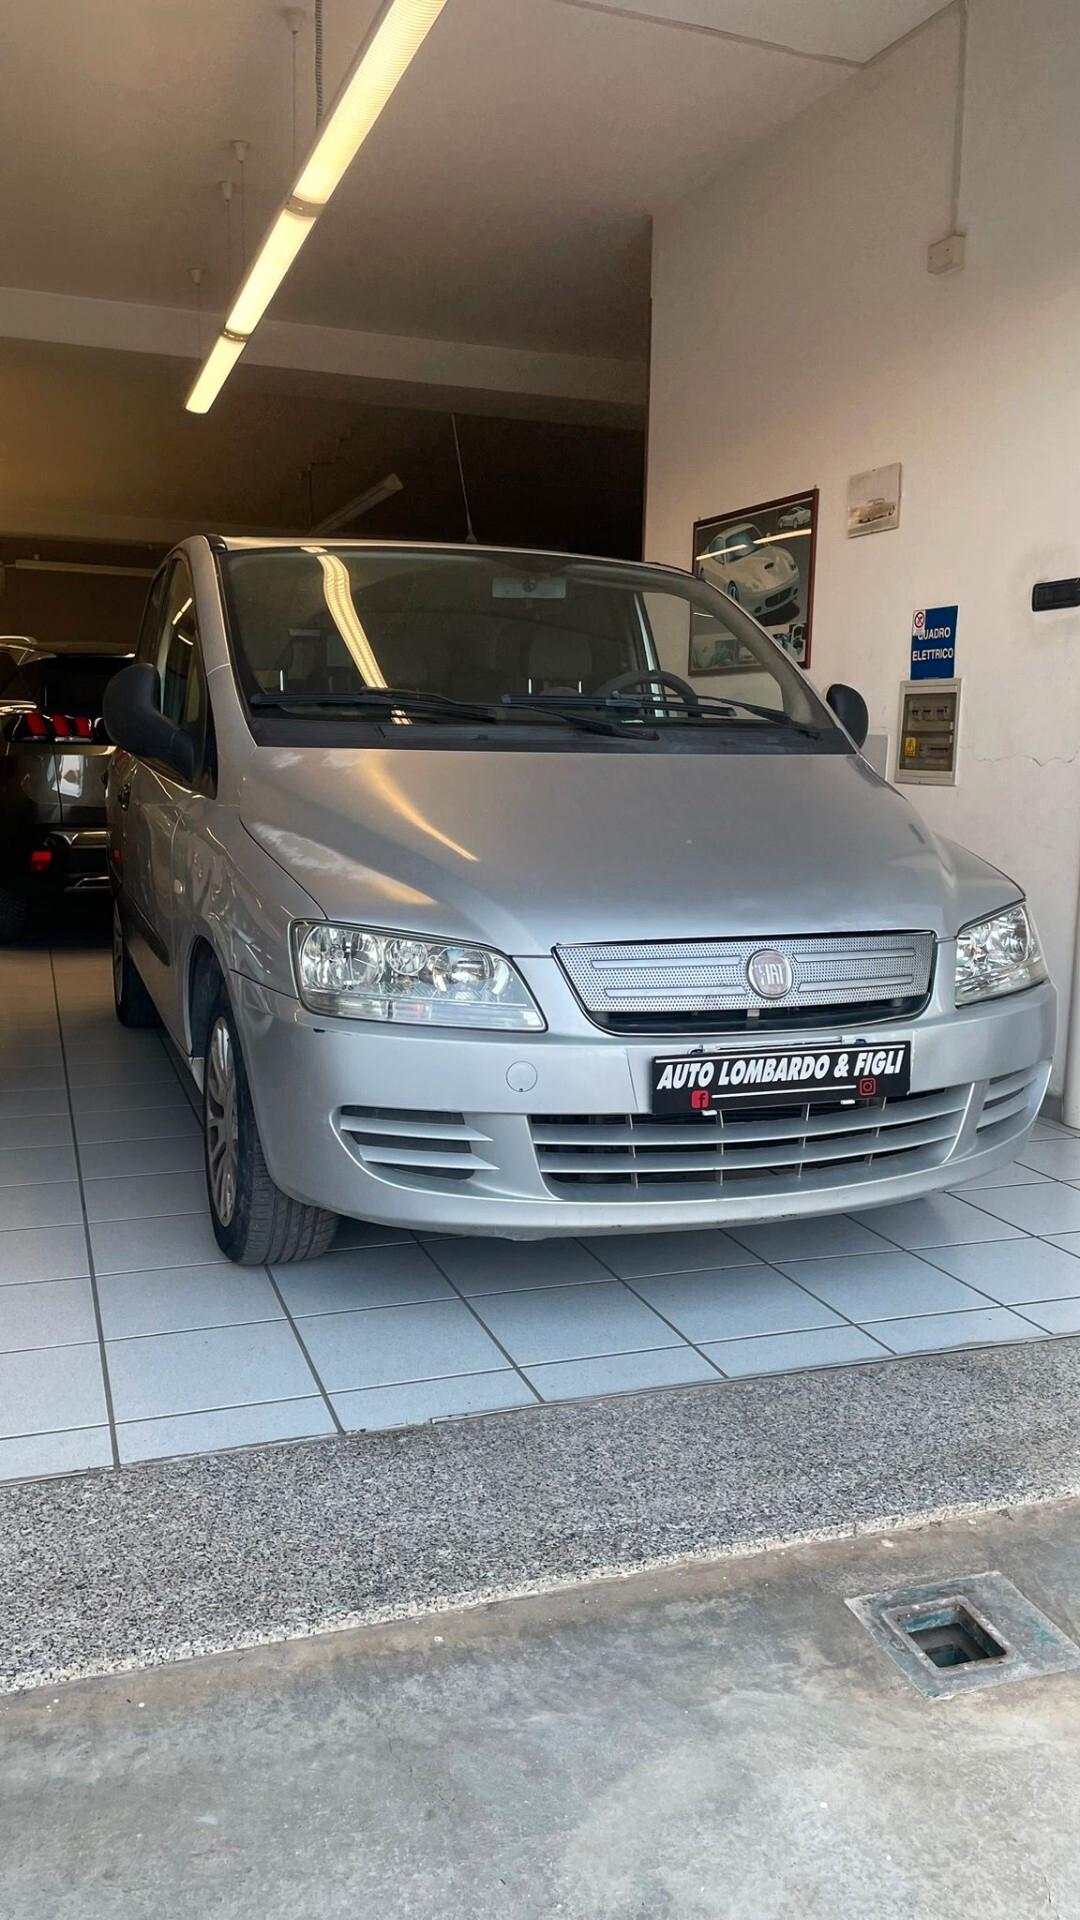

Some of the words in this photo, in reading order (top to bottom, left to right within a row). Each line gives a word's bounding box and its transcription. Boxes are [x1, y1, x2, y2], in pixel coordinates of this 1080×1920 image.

[912, 648, 954, 661] ELETTRICO
[754, 963, 784, 985] FIAT
[656, 1061, 715, 1090] AUTO
[718, 1055, 831, 1086] LOMBARDO
[833, 1053, 849, 1078] &
[853, 1050, 905, 1077] FIGLI
